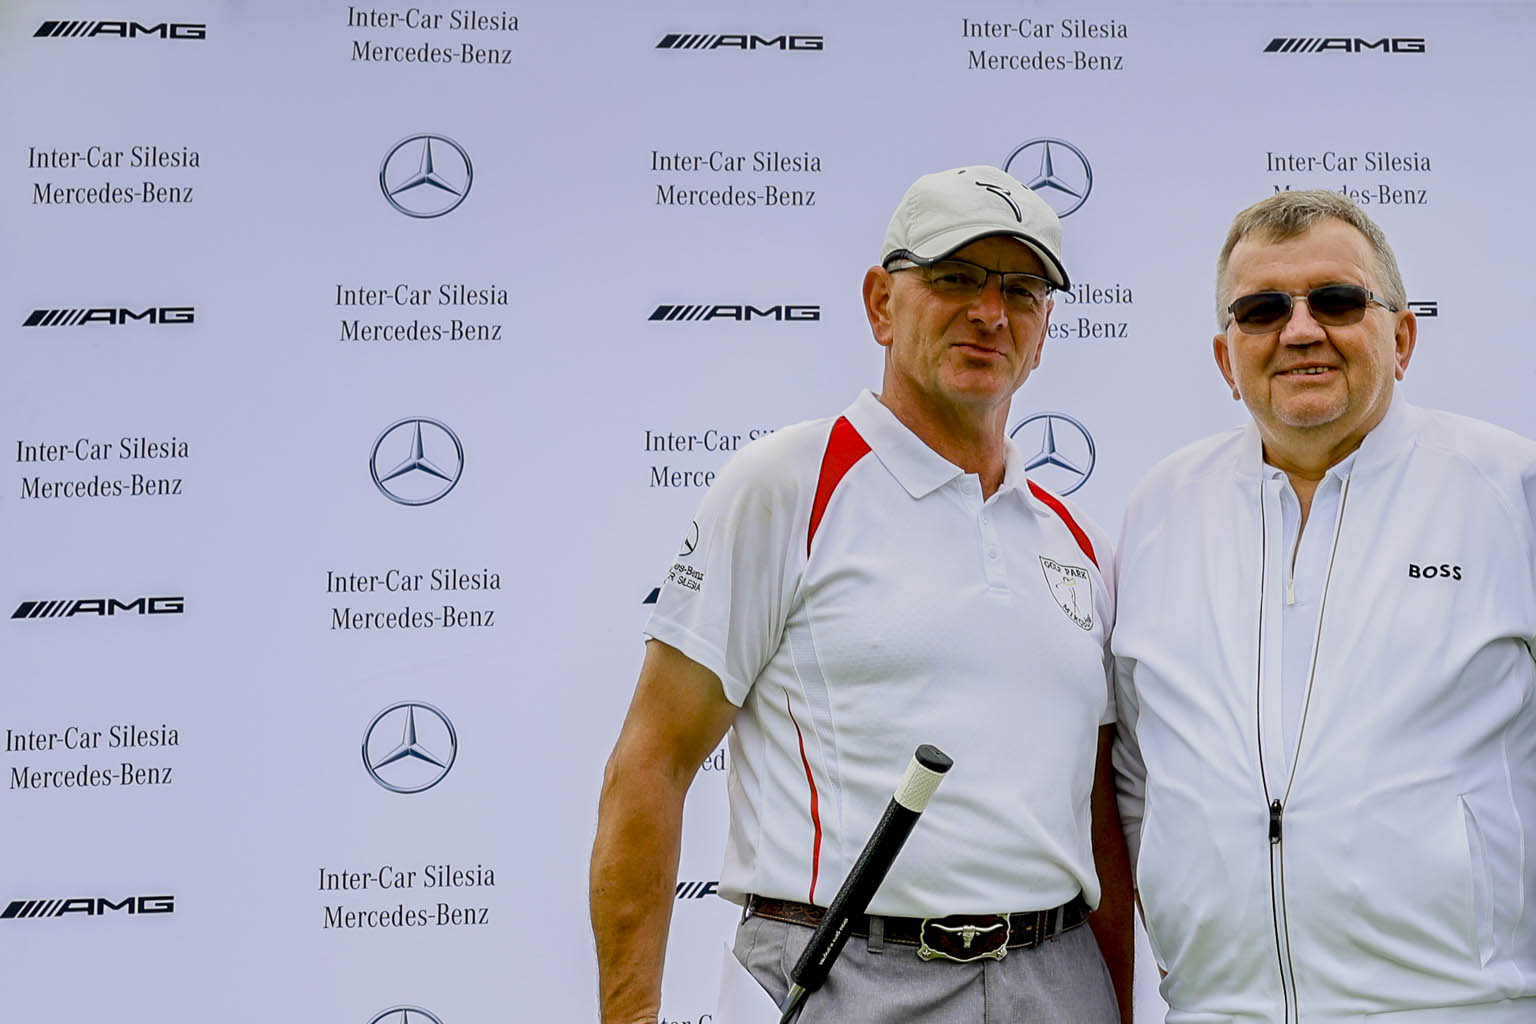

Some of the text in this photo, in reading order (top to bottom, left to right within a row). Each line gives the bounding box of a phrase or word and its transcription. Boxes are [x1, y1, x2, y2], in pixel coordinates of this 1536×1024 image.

[349, 7, 518, 31] Inter-Car Silesia
[962, 19, 1128, 38] Inter-Car Silesia
[93, 21, 206, 40] AMG
[353, 41, 511, 64] Mercedes-Benz
[714, 34, 823, 50] AMG
[1320, 38, 1425, 53] AMG
[968, 50, 1123, 70] Mercedes-Benz
[28, 146, 200, 168] Inter-Car Silesia
[651, 151, 821, 172] Inter-Car Silesia
[1266, 152, 1431, 171] Inter-Car Silesia
[32, 182, 193, 204] Mercedes-Benz
[656, 185, 815, 206] Mercedes-Benz
[336, 284, 508, 305] Inter-Car Silesia
[82, 307, 195, 327] AMG
[708, 305, 820, 321] AMG
[340, 320, 501, 341] Mercedes-Benz
[16, 437, 189, 462] Inter-Car Silesia
[645, 430, 741, 451] Inter-Car
[21, 474, 183, 499] Mercedes-Benz
[327, 569, 501, 592] Inter-Car Silesia
[1409, 563, 1462, 581] BOSS
[71, 597, 184, 619] AMG
[331, 606, 494, 629] Mercedes-Benz
[6, 724, 179, 751] Inter-Car Silesia
[10, 763, 172, 789] Mercedes-Benz
[318, 864, 495, 890] Inter-Car Silesia
[58, 896, 174, 919] AMG
[323, 903, 488, 928] Mercedes-Benz
